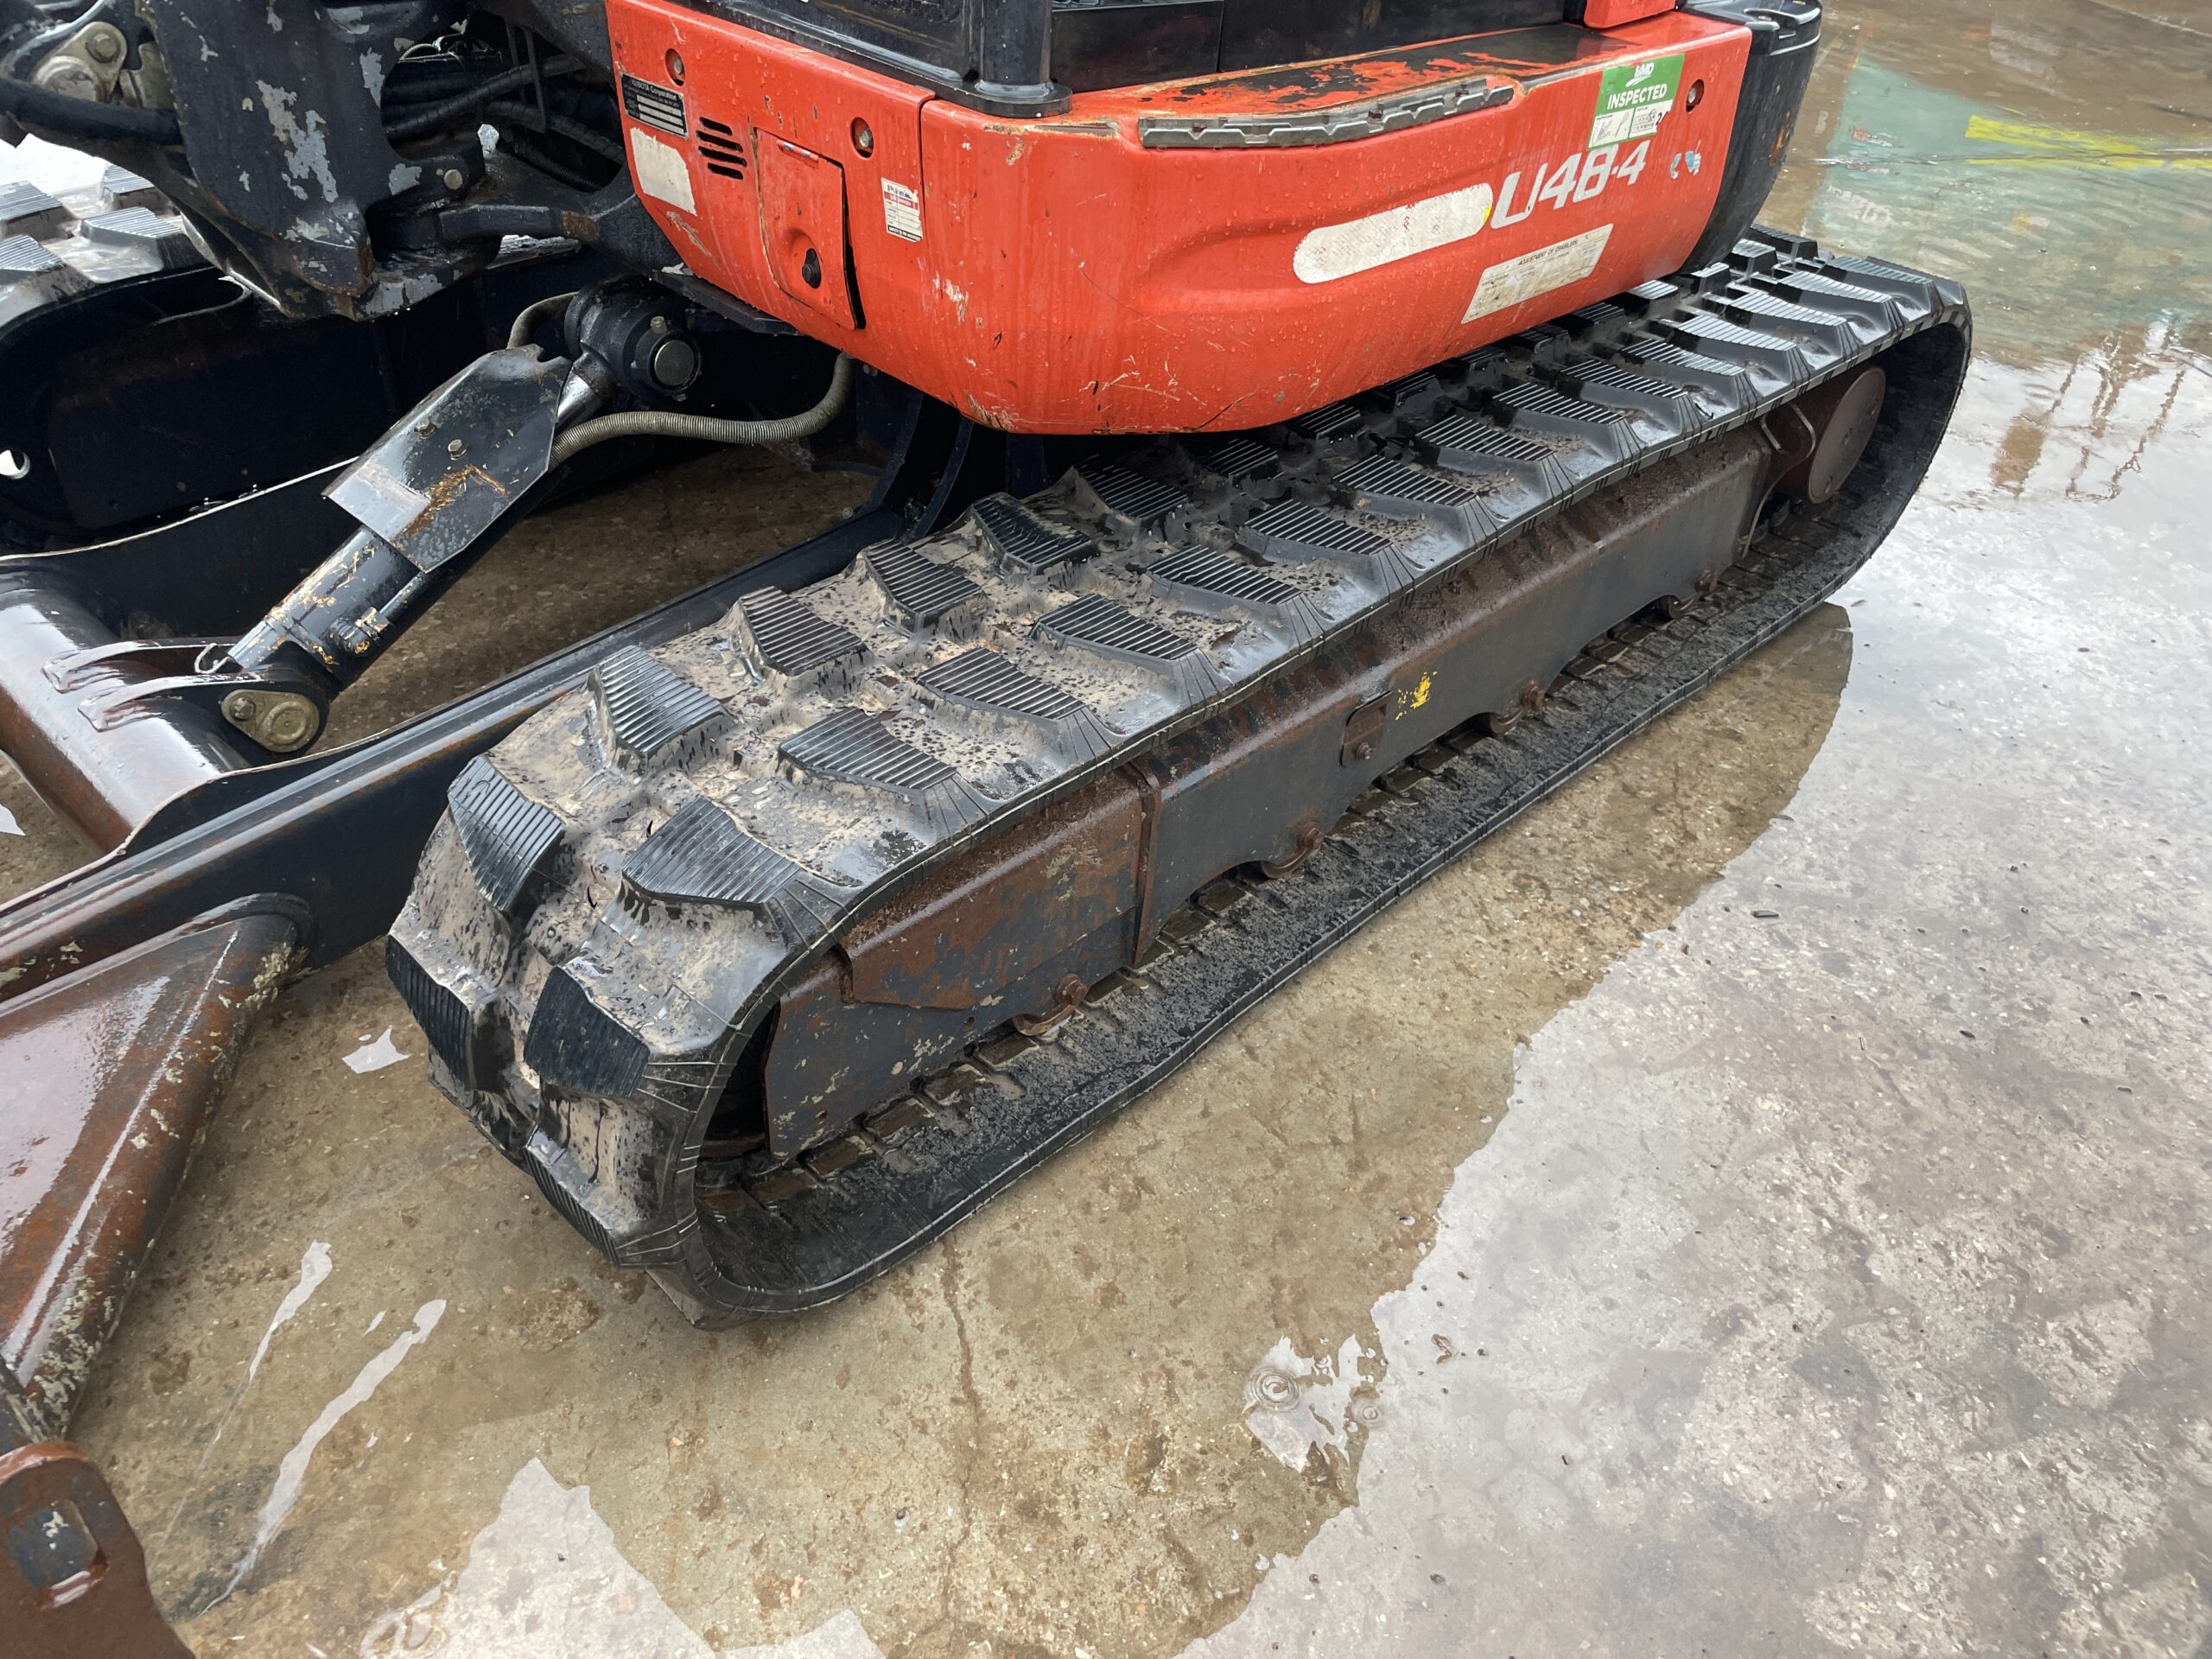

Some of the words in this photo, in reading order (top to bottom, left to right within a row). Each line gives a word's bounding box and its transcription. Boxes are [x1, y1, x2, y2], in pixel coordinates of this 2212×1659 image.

[632, 79, 650, 91] KUBOTA
[650, 86, 677, 101] Corporation
[1606, 83, 1668, 111] INSPECTED
[1491, 139, 1651, 229] U48-4
[1517, 251, 1548, 266] ADJUSTMENT
[1547, 248, 1556, 257] OF
